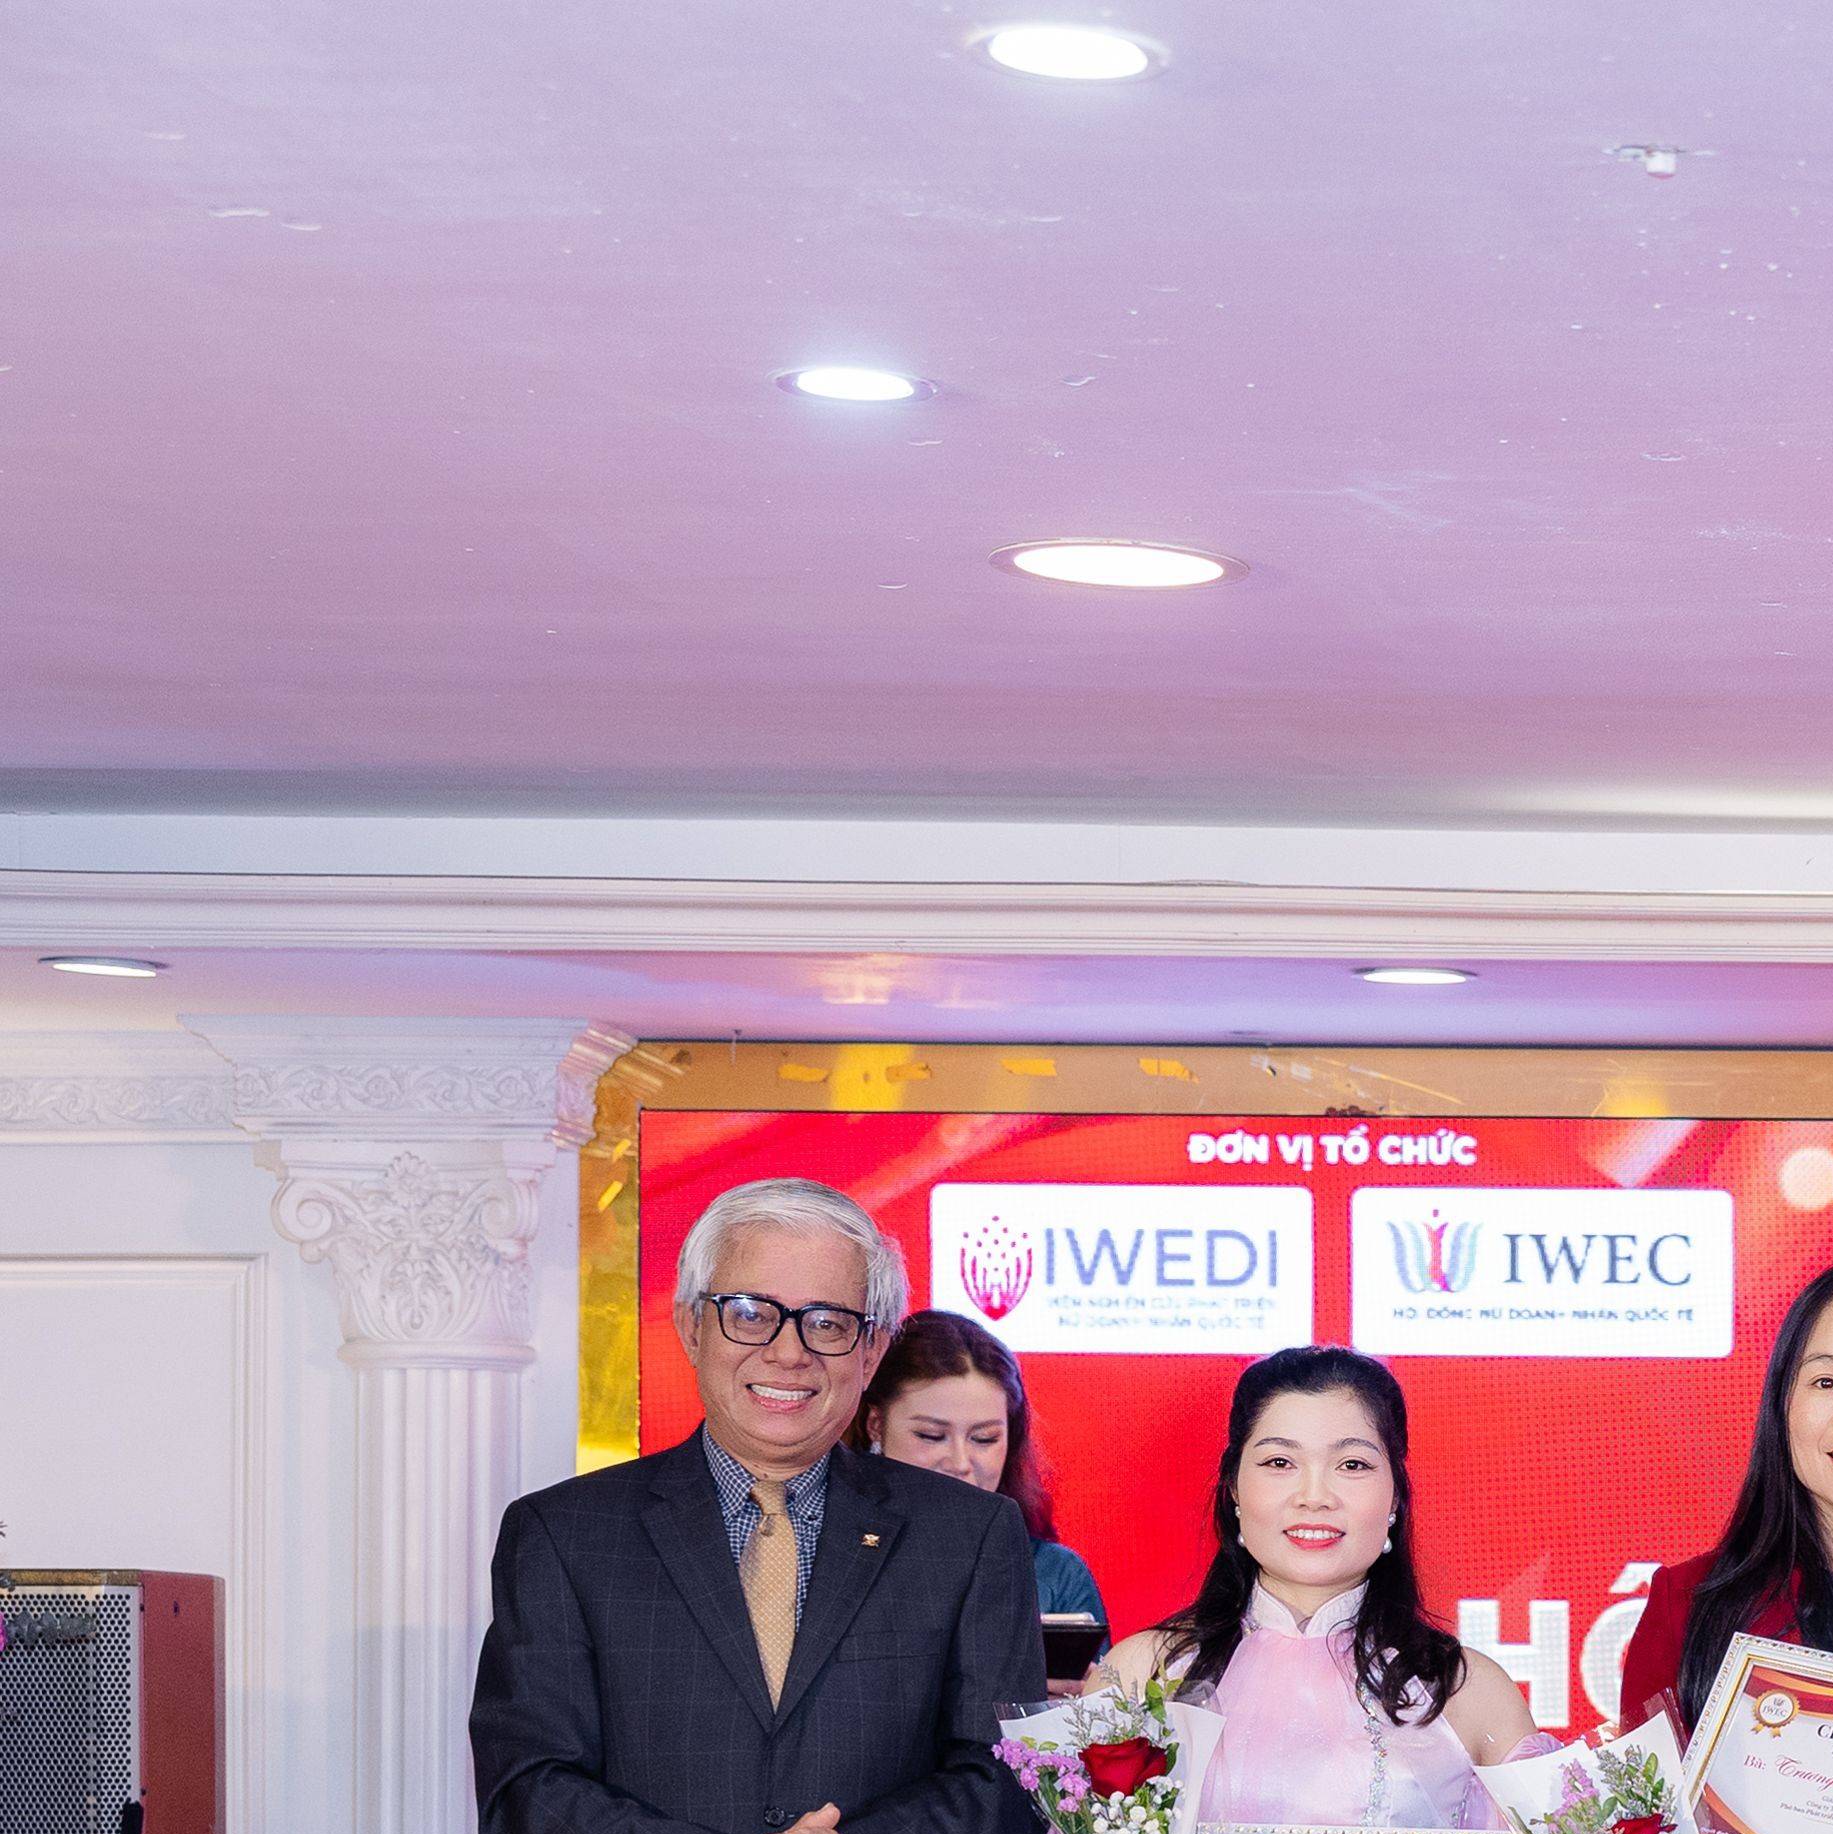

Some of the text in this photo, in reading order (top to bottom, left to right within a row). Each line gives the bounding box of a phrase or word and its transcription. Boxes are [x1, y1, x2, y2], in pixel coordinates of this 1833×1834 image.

[1187, 1128, 1270, 1164] ĐƠN
[1275, 1134, 1314, 1171] VỊ
[1377, 1128, 1478, 1166] CHỨC
[1045, 1228, 1277, 1287] IWEDI
[1502, 1233, 1691, 1286] IWEC
[1762, 1704, 1788, 1718] IWEC
